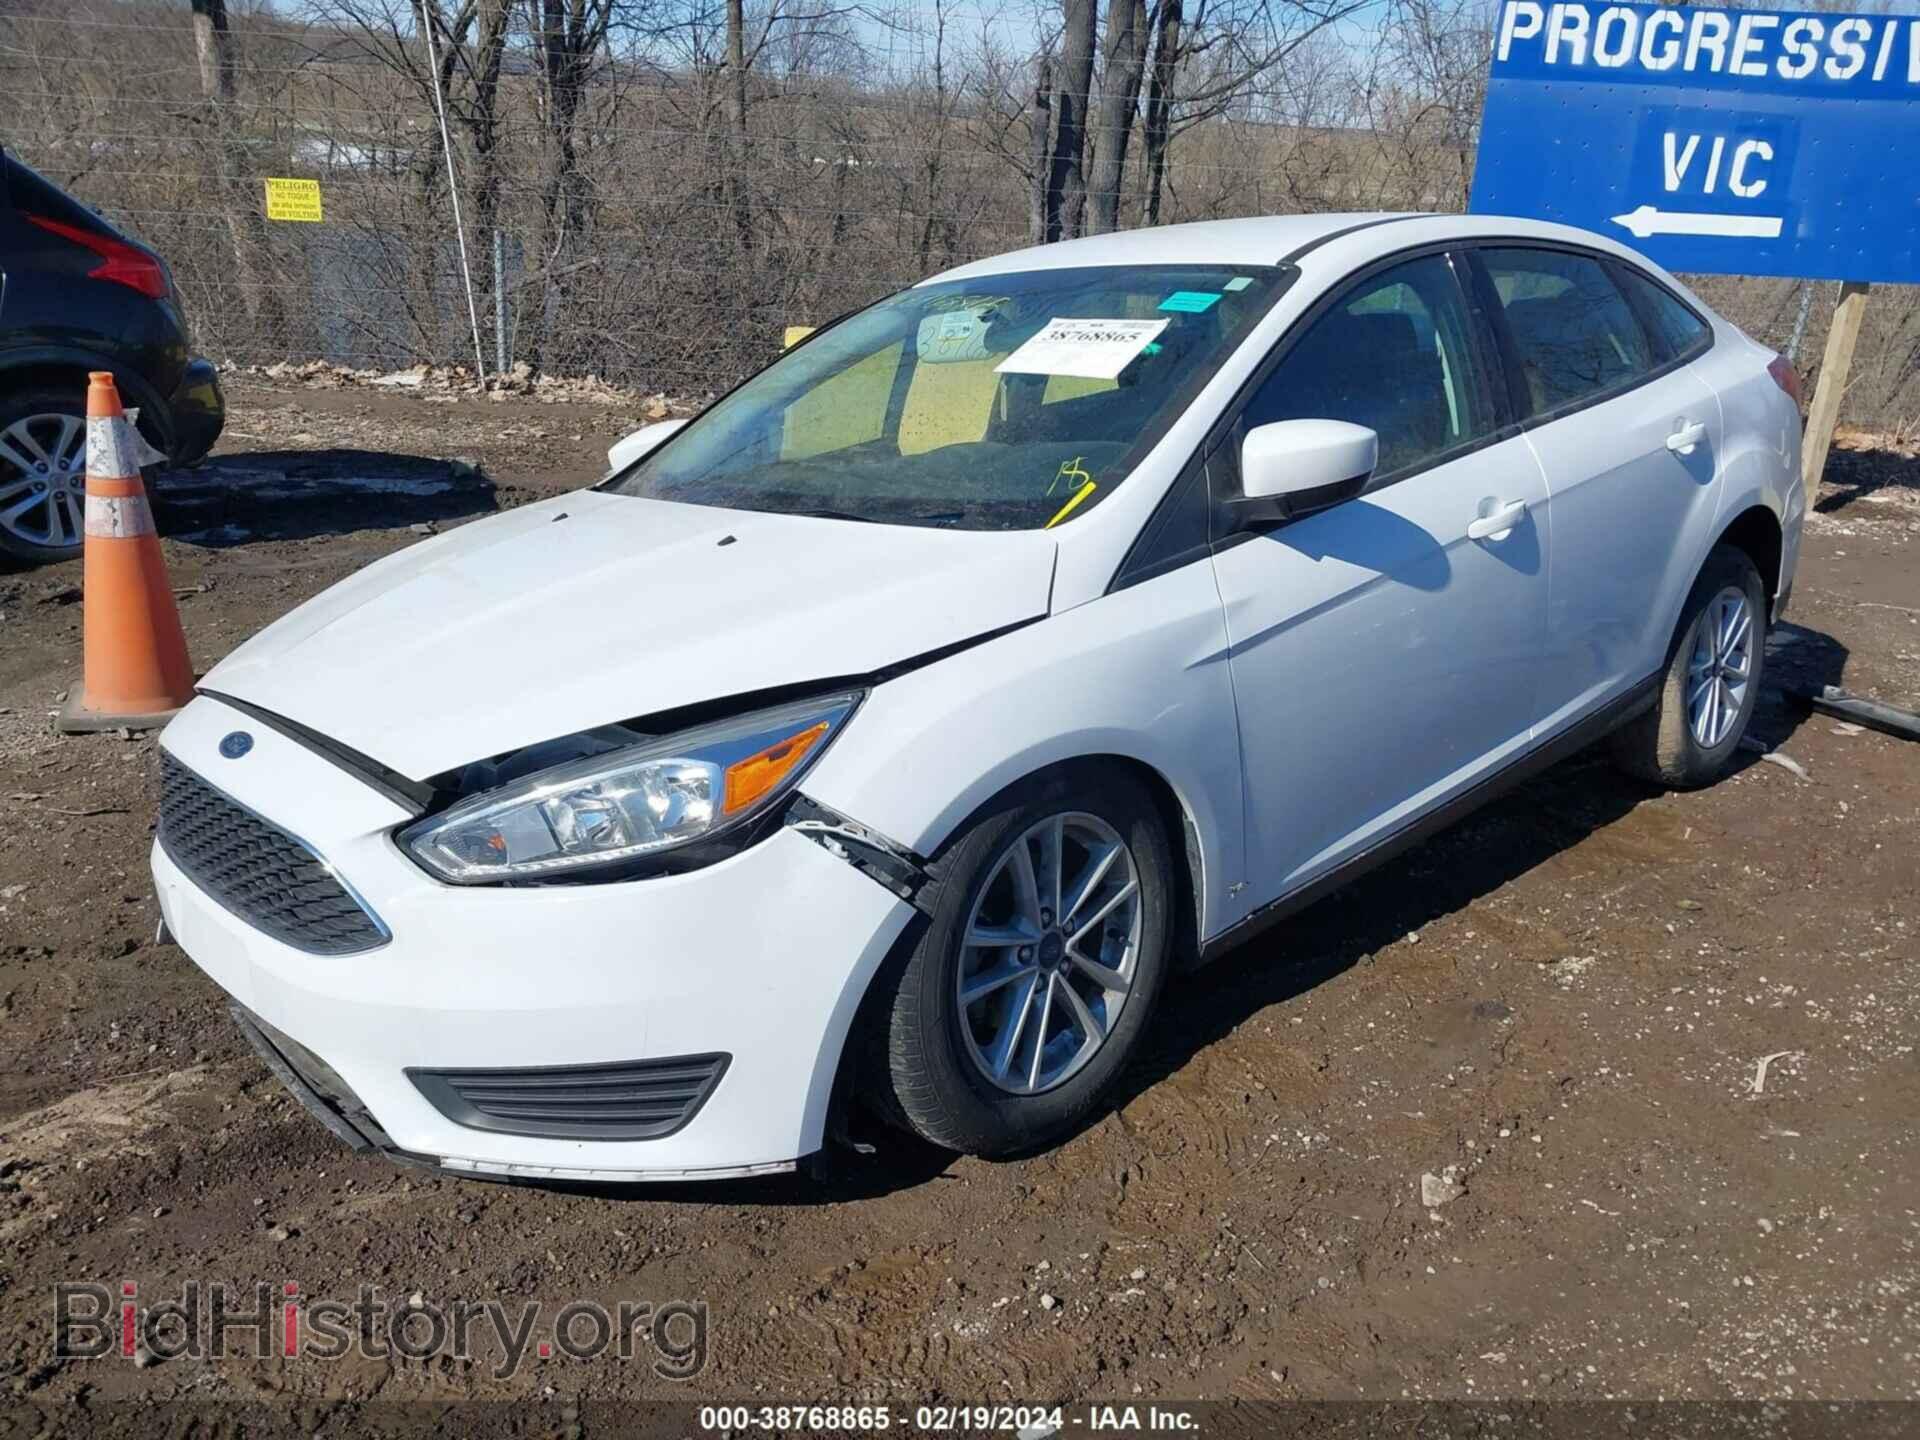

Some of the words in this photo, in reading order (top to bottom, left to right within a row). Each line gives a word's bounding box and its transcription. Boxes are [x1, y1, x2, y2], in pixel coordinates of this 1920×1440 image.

[1497, 1, 1920, 83] PROGRESSI
[1663, 132, 1774, 198] VIC
[269, 181, 318, 191] PELIGRO
[1042, 330, 1142, 343] 38768865
